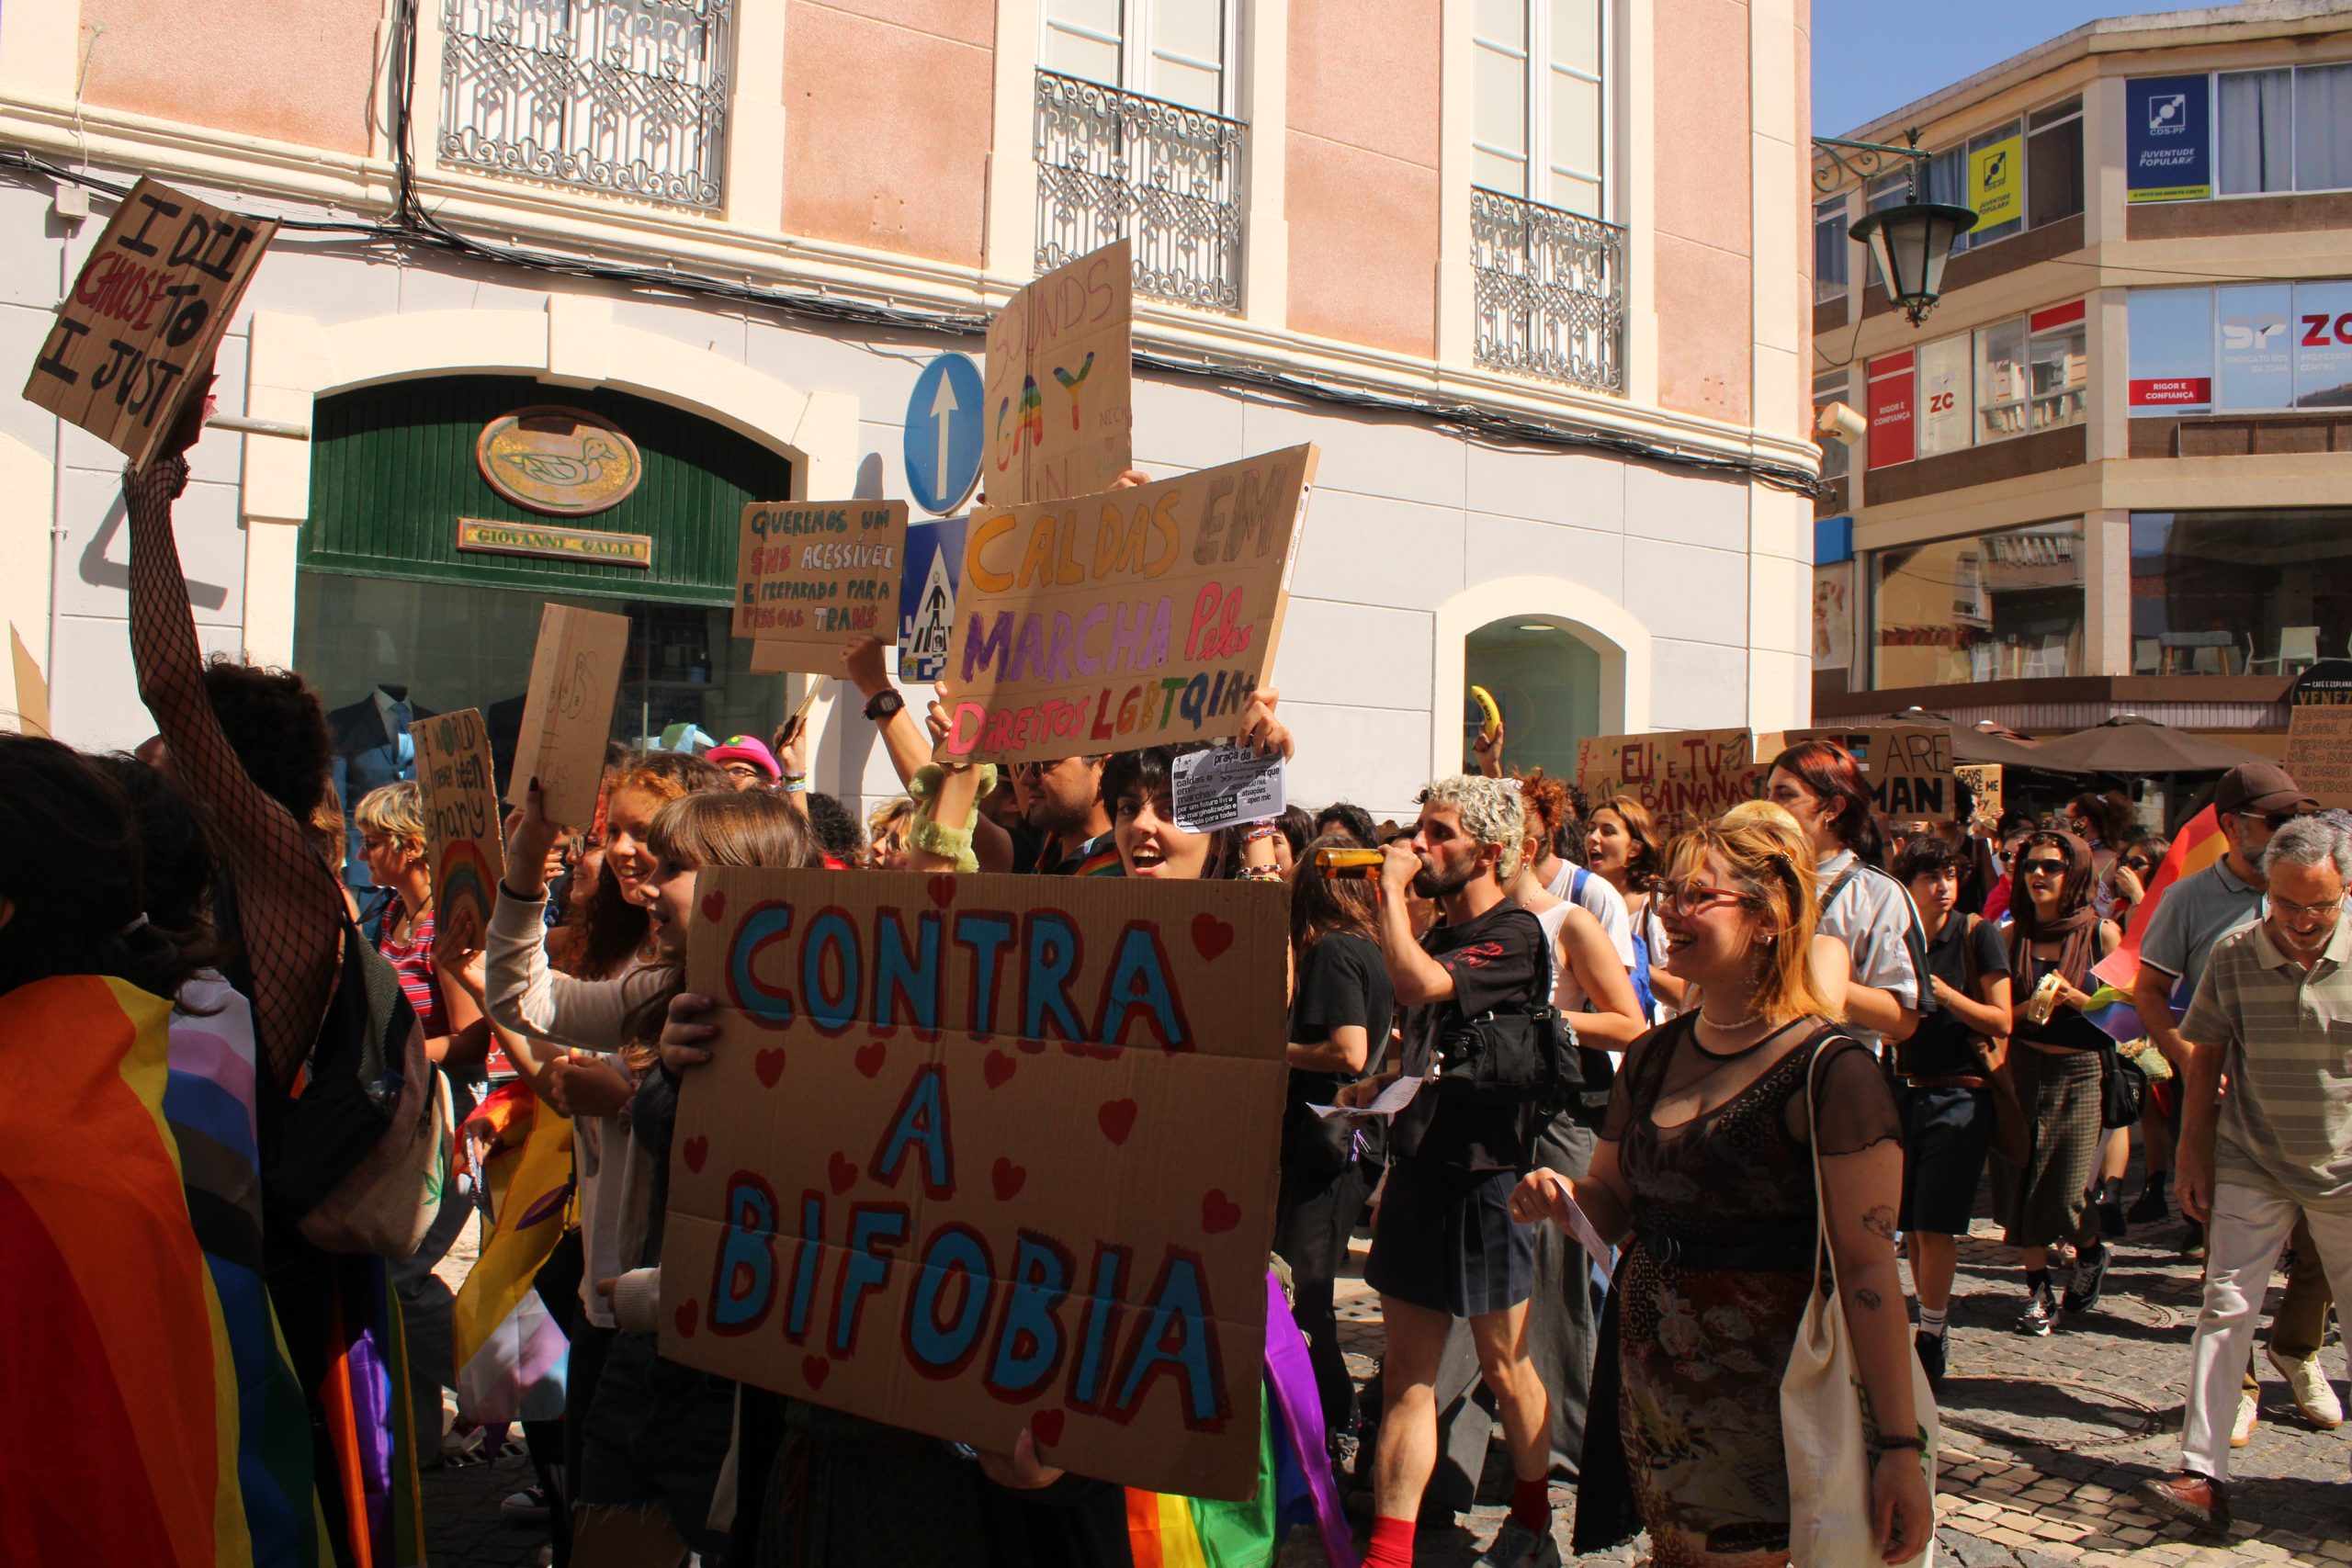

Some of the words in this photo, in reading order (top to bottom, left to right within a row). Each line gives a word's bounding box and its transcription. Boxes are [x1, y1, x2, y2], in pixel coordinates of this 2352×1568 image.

[2141, 148, 2195, 159] JUVENTUDE
[118, 193, 183, 258] I
[157, 284, 209, 347] TO
[38, 317, 91, 385] I
[91, 338, 184, 428] JUST
[2301, 363, 2336, 372] CENTRO
[2145, 391, 2195, 400] CONFIANÇA
[2153, 382, 2179, 391] RIGOR
[996, 351, 1095, 472] GAY
[1879, 402, 1900, 415] RIGOR
[1900, 401, 1905, 411] E
[1929, 392, 1954, 413] ZC
[1873, 412, 1911, 427] CONFIANÇA
[752, 509, 848, 542] QUEREMOS
[862, 509, 890, 530] UM
[967, 490, 1180, 592] CALDAS
[1193, 463, 1286, 565] EM
[477, 529, 566, 549] GIOVANNI
[581, 540, 636, 556] GALLI
[752, 545, 792, 575] SNS
[801, 532, 895, 571] ACESSÍVEL
[743, 583, 755, 604] E
[762, 581, 838, 602] PREPARADO
[847, 580, 889, 601] PARA
[743, 606, 805, 629] PESSOAS
[814, 605, 879, 632] TRANS
[960, 595, 1174, 683] MARCHA
[1090, 669, 1255, 741] LGBTQIA+
[1214, 751, 1239, 767] praça
[1240, 750, 1251, 761] da
[1884, 734, 1952, 773] ARE
[455, 754, 485, 790] been
[1176, 774, 1204, 788] caldas
[1255, 768, 1280, 780] parque
[1958, 769, 1983, 780] GAYS
[1241, 786, 1266, 797] atuações
[1985, 780, 1999, 792] ME
[1177, 805, 1189, 815] por
[1189, 803, 1200, 811] um
[1200, 798, 1218, 809] futuro
[1261, 794, 1272, 802] mic
[1177, 813, 1187, 821] de
[1187, 803, 1232, 819] marginalização
[1204, 813, 1220, 824] para
[1219, 810, 1238, 820] todes
[725, 898, 1196, 1058] CONTRA
[868, 1061, 957, 1201] A
[707, 1169, 1233, 1433] BIFOBIA
